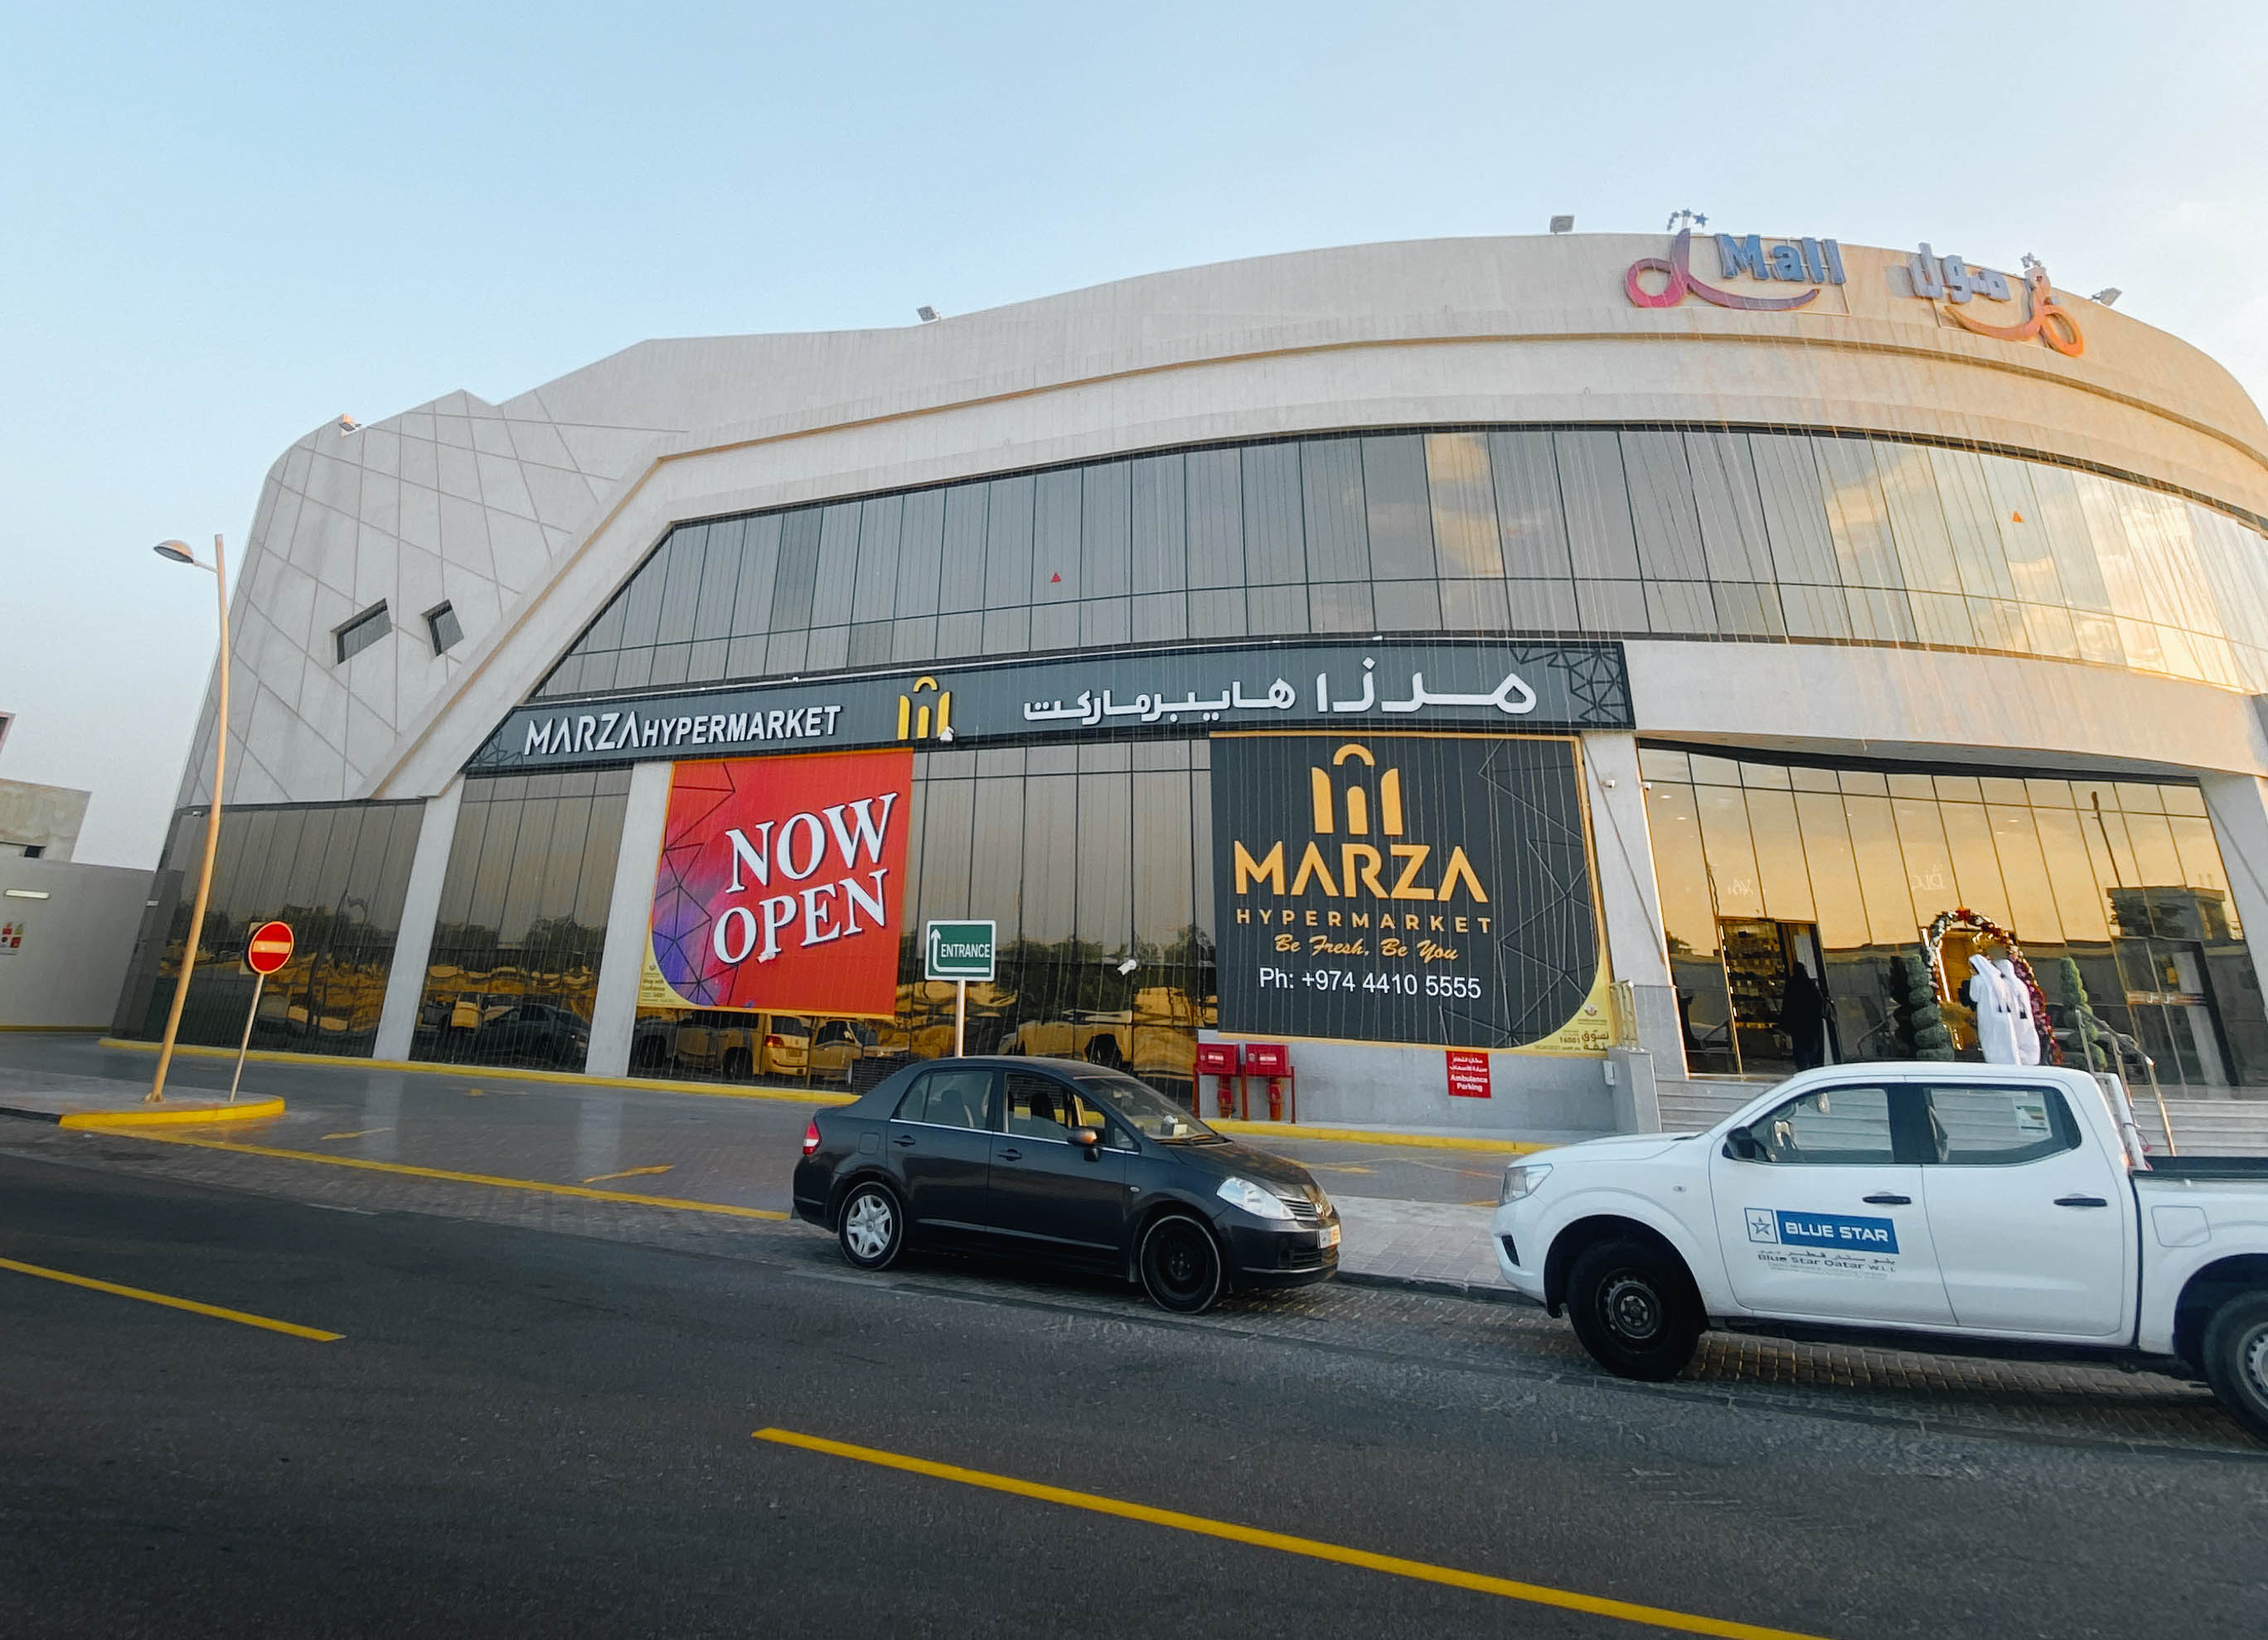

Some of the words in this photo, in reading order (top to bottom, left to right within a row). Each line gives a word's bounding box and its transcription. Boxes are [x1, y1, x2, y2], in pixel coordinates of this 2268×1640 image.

[1714, 233, 1846, 285] Mall
[1316, 656, 1537, 714] مرزا
[1023, 677, 1296, 726] هايبرماركت
[642, 705, 841, 747] HYPERMARKET
[725, 791, 898, 894] NOW
[1233, 839, 1490, 903] MARZA
[713, 868, 889, 965] OPEN
[1236, 908, 1491, 934] HYPERMARKET
[941, 943, 991, 958] ENTRANCE
[1274, 933, 1301, 952] Be
[1309, 935, 1369, 956] Fresh,
[1380, 937, 1408, 956] Be
[1416, 939, 1459, 964] You
[1259, 967, 1294, 989] Ph:
[1301, 970, 1355, 992] +974
[1362, 973, 1418, 994] 4410
[1425, 975, 1481, 999] 5555
[1451, 1074, 1488, 1083] Ambulance
[1456, 1082, 1483, 1092] Parking
[1785, 1222, 1834, 1238] BLUE
[1839, 1226, 1888, 1242] STAR
[1757, 1253, 1787, 1262] Blue
[1791, 1256, 1820, 1265] Star
[1824, 1260, 1864, 1270] Qatar
